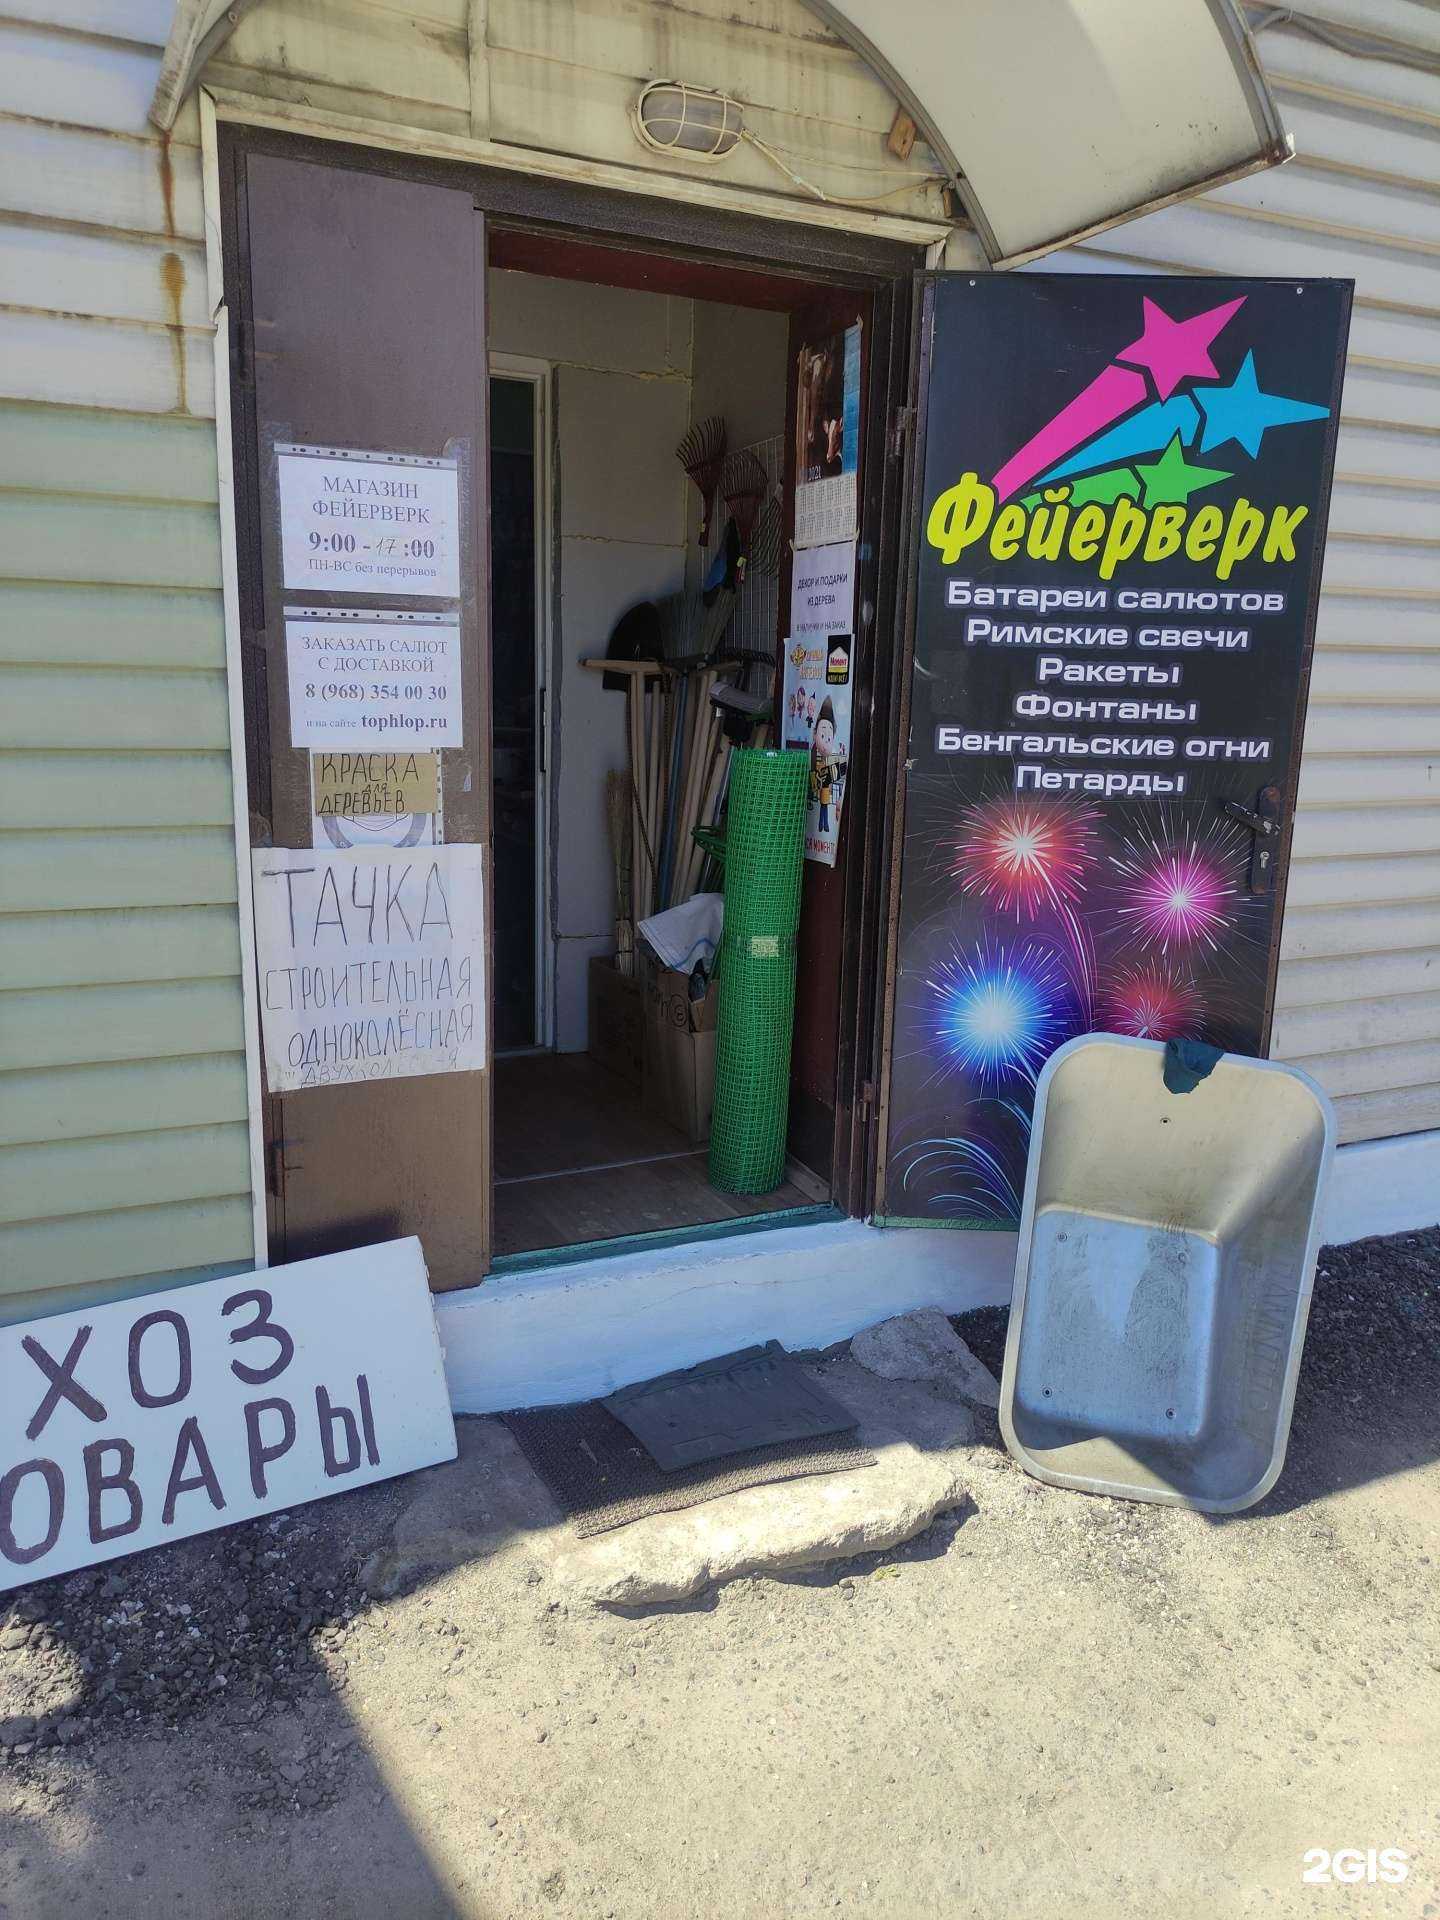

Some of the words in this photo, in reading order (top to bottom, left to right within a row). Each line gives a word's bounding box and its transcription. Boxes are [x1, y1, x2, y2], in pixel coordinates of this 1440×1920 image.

[323, 476, 418, 499] МАГАЗИН
[312, 499, 430, 524] ФЕЙЕРВЕРК
[926, 472, 1309, 580] Фейерверк
[308, 531, 356, 553] 9:00
[308, 558, 351, 574] ПН-ВС
[355, 560, 374, 575] без
[376, 563, 437, 579] перерывов
[798, 577, 815, 591] ДЕКОР
[820, 573, 848, 587] ПОДАРКИ
[815, 594, 836, 608] ДЕРЕВА
[948, 580, 1107, 613] Батареи
[1117, 590, 1285, 612] салютов
[301, 636, 386, 653] ЗАКАЗАТЬ
[389, 638, 449, 655] САЛЮТ
[967, 619, 1129, 647] Римские
[1138, 628, 1249, 649] свечи
[318, 656, 329, 671] С
[333, 654, 435, 674] ДОСТАВКОЙ
[1039, 657, 1180, 684] Ракеты
[305, 682, 316, 697] 8
[321, 682, 365, 701] (968)
[370, 683, 400, 700] 354
[404, 685, 423, 700] 00
[427, 685, 448, 701] 30
[1016, 694, 1197, 721] Фонтаны
[328, 718, 357, 729] сайте
[361, 712, 448, 731] tophlop.ru
[938, 728, 1175, 757] Бенгальские
[1185, 739, 1271, 758] огни
[321, 753, 419, 784] КРАСКА
[1017, 766, 1185, 795] Петарды
[319, 789, 405, 815] ДЕРЕВЬЕВ
[362, 783, 390, 795] для
[261, 862, 454, 948] ТАЧКА
[265, 956, 472, 1011] СТРОИТЕЛЬНАЯ
[287, 1003, 474, 1069] ОДНОКОЛЁСНАЯ
[21, 1288, 295, 1441] ХОЗ
